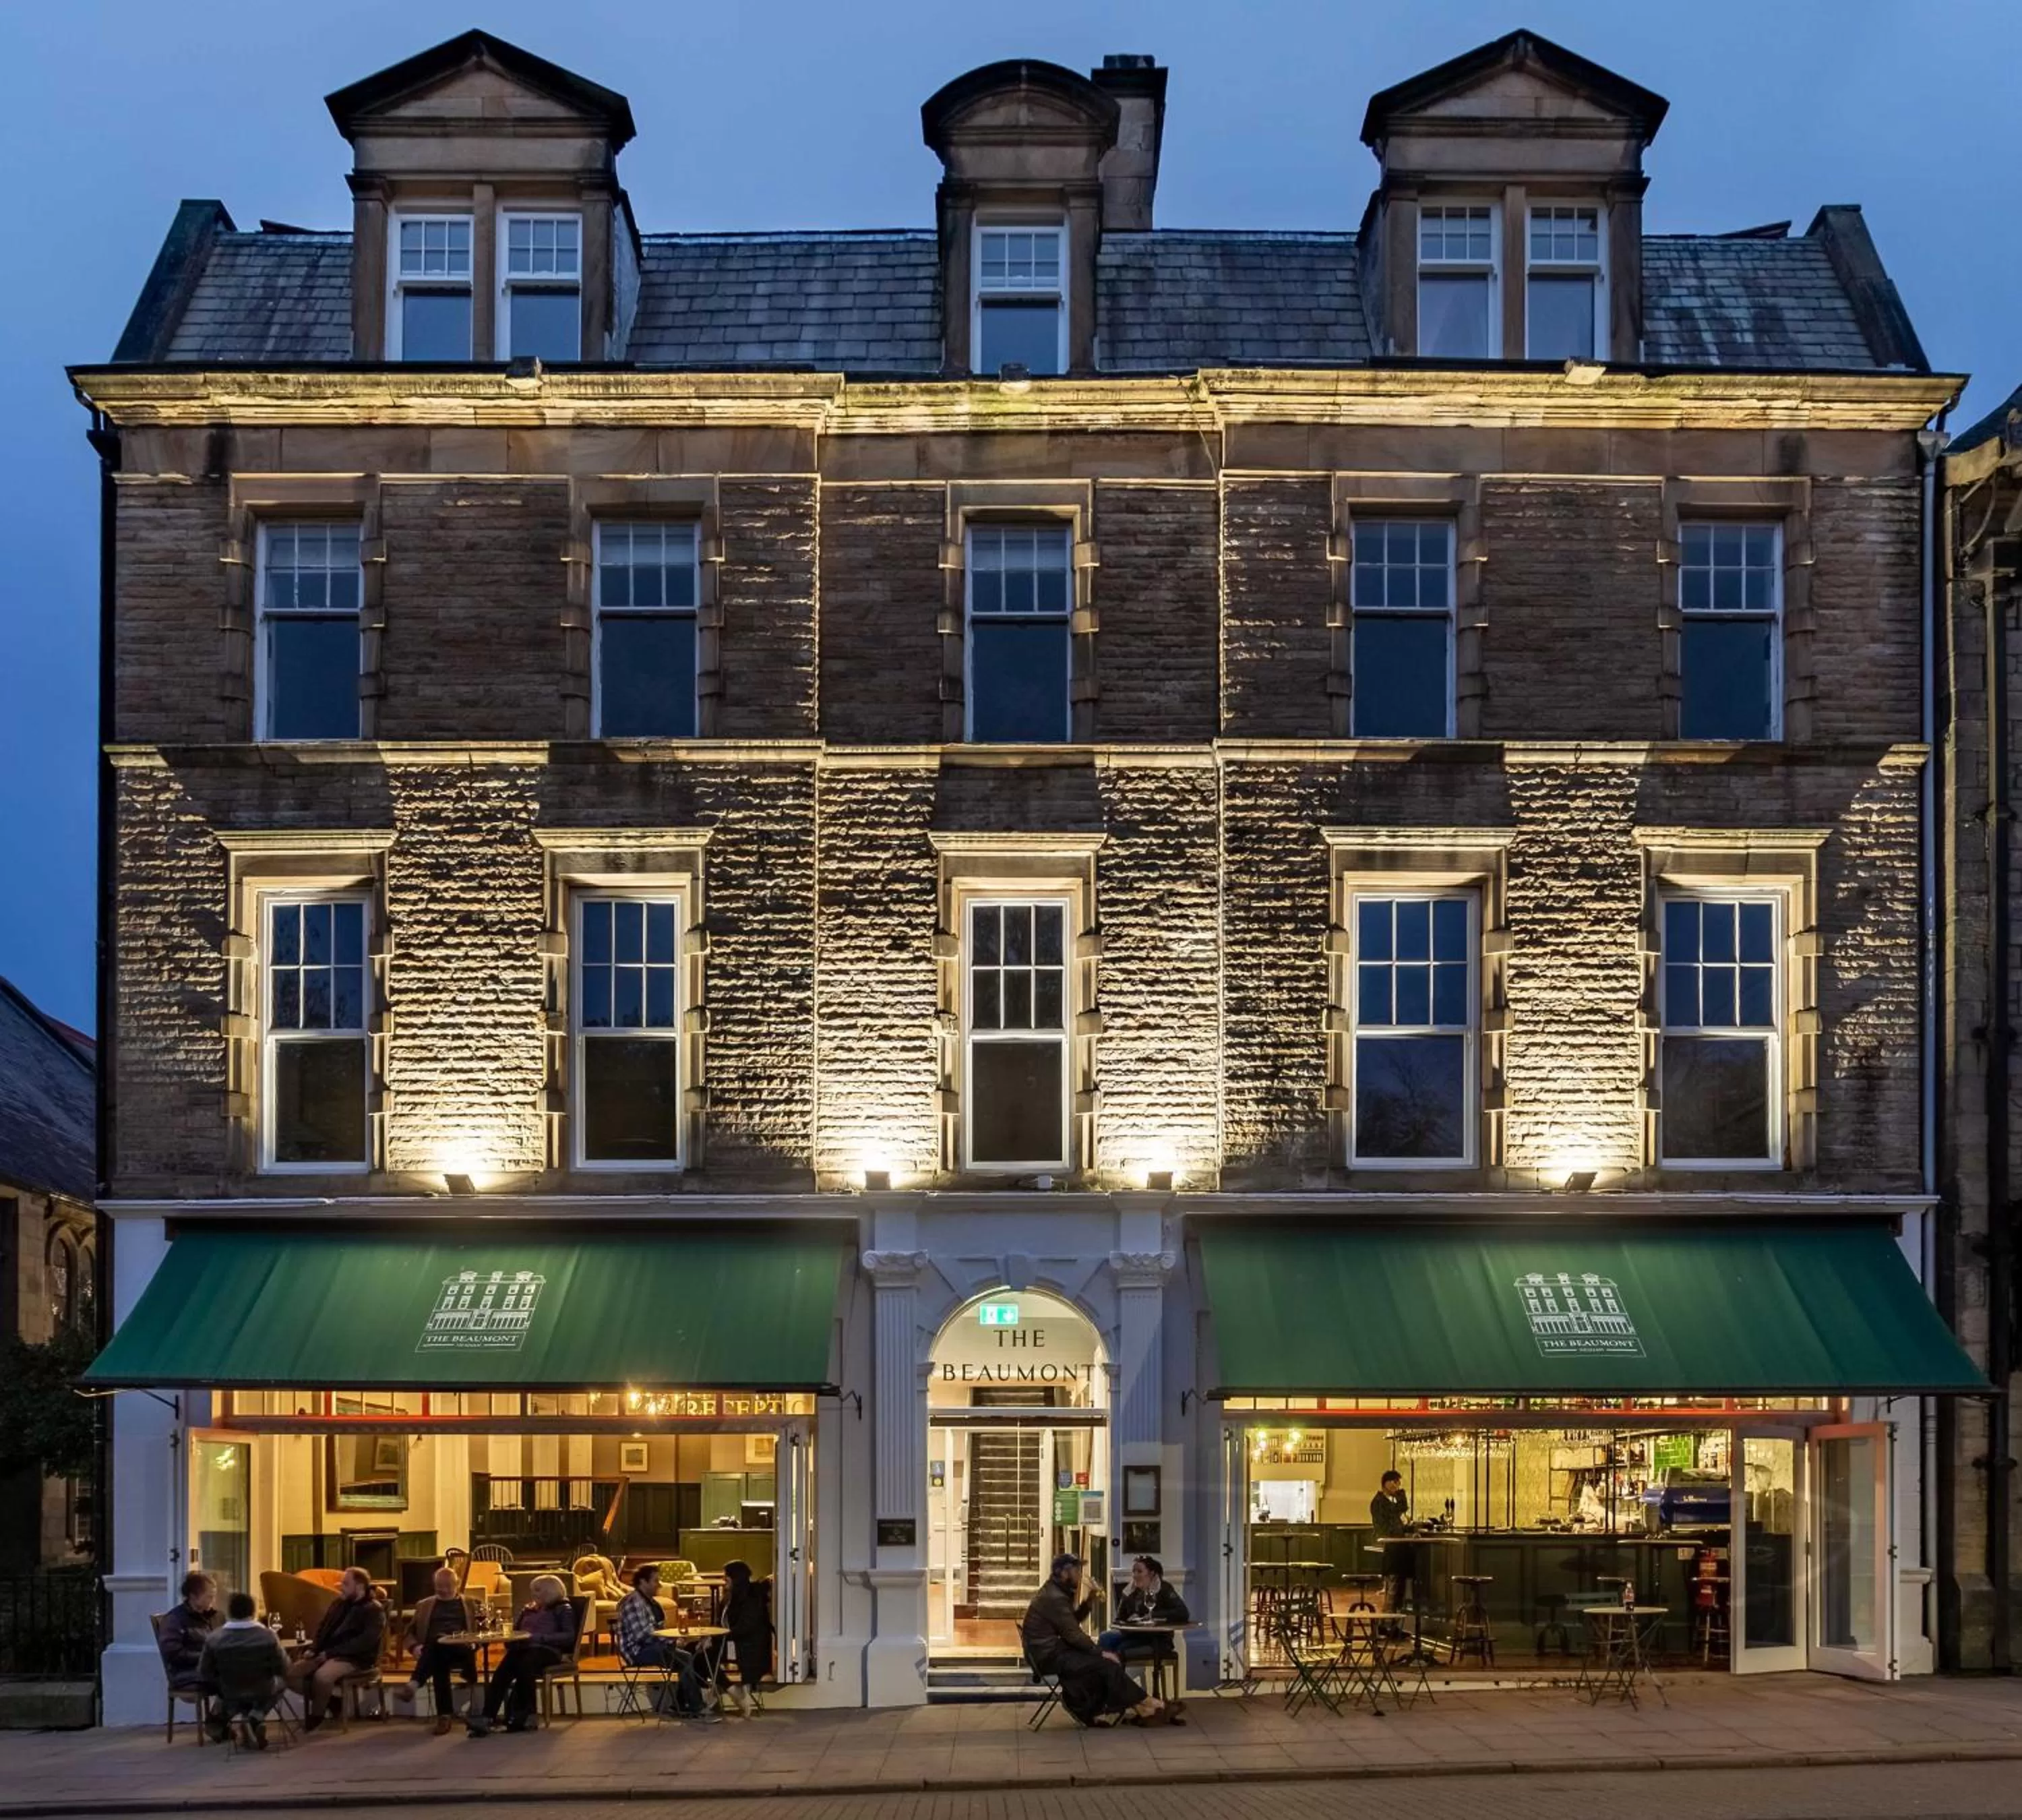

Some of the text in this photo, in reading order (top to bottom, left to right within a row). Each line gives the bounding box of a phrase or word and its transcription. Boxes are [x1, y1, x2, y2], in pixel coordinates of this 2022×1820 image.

[993, 1330, 1045, 1347] THE
[1542, 1339, 1634, 1347] THE BEAUMONT
[942, 1364, 1095, 1382] BEAUMONT
